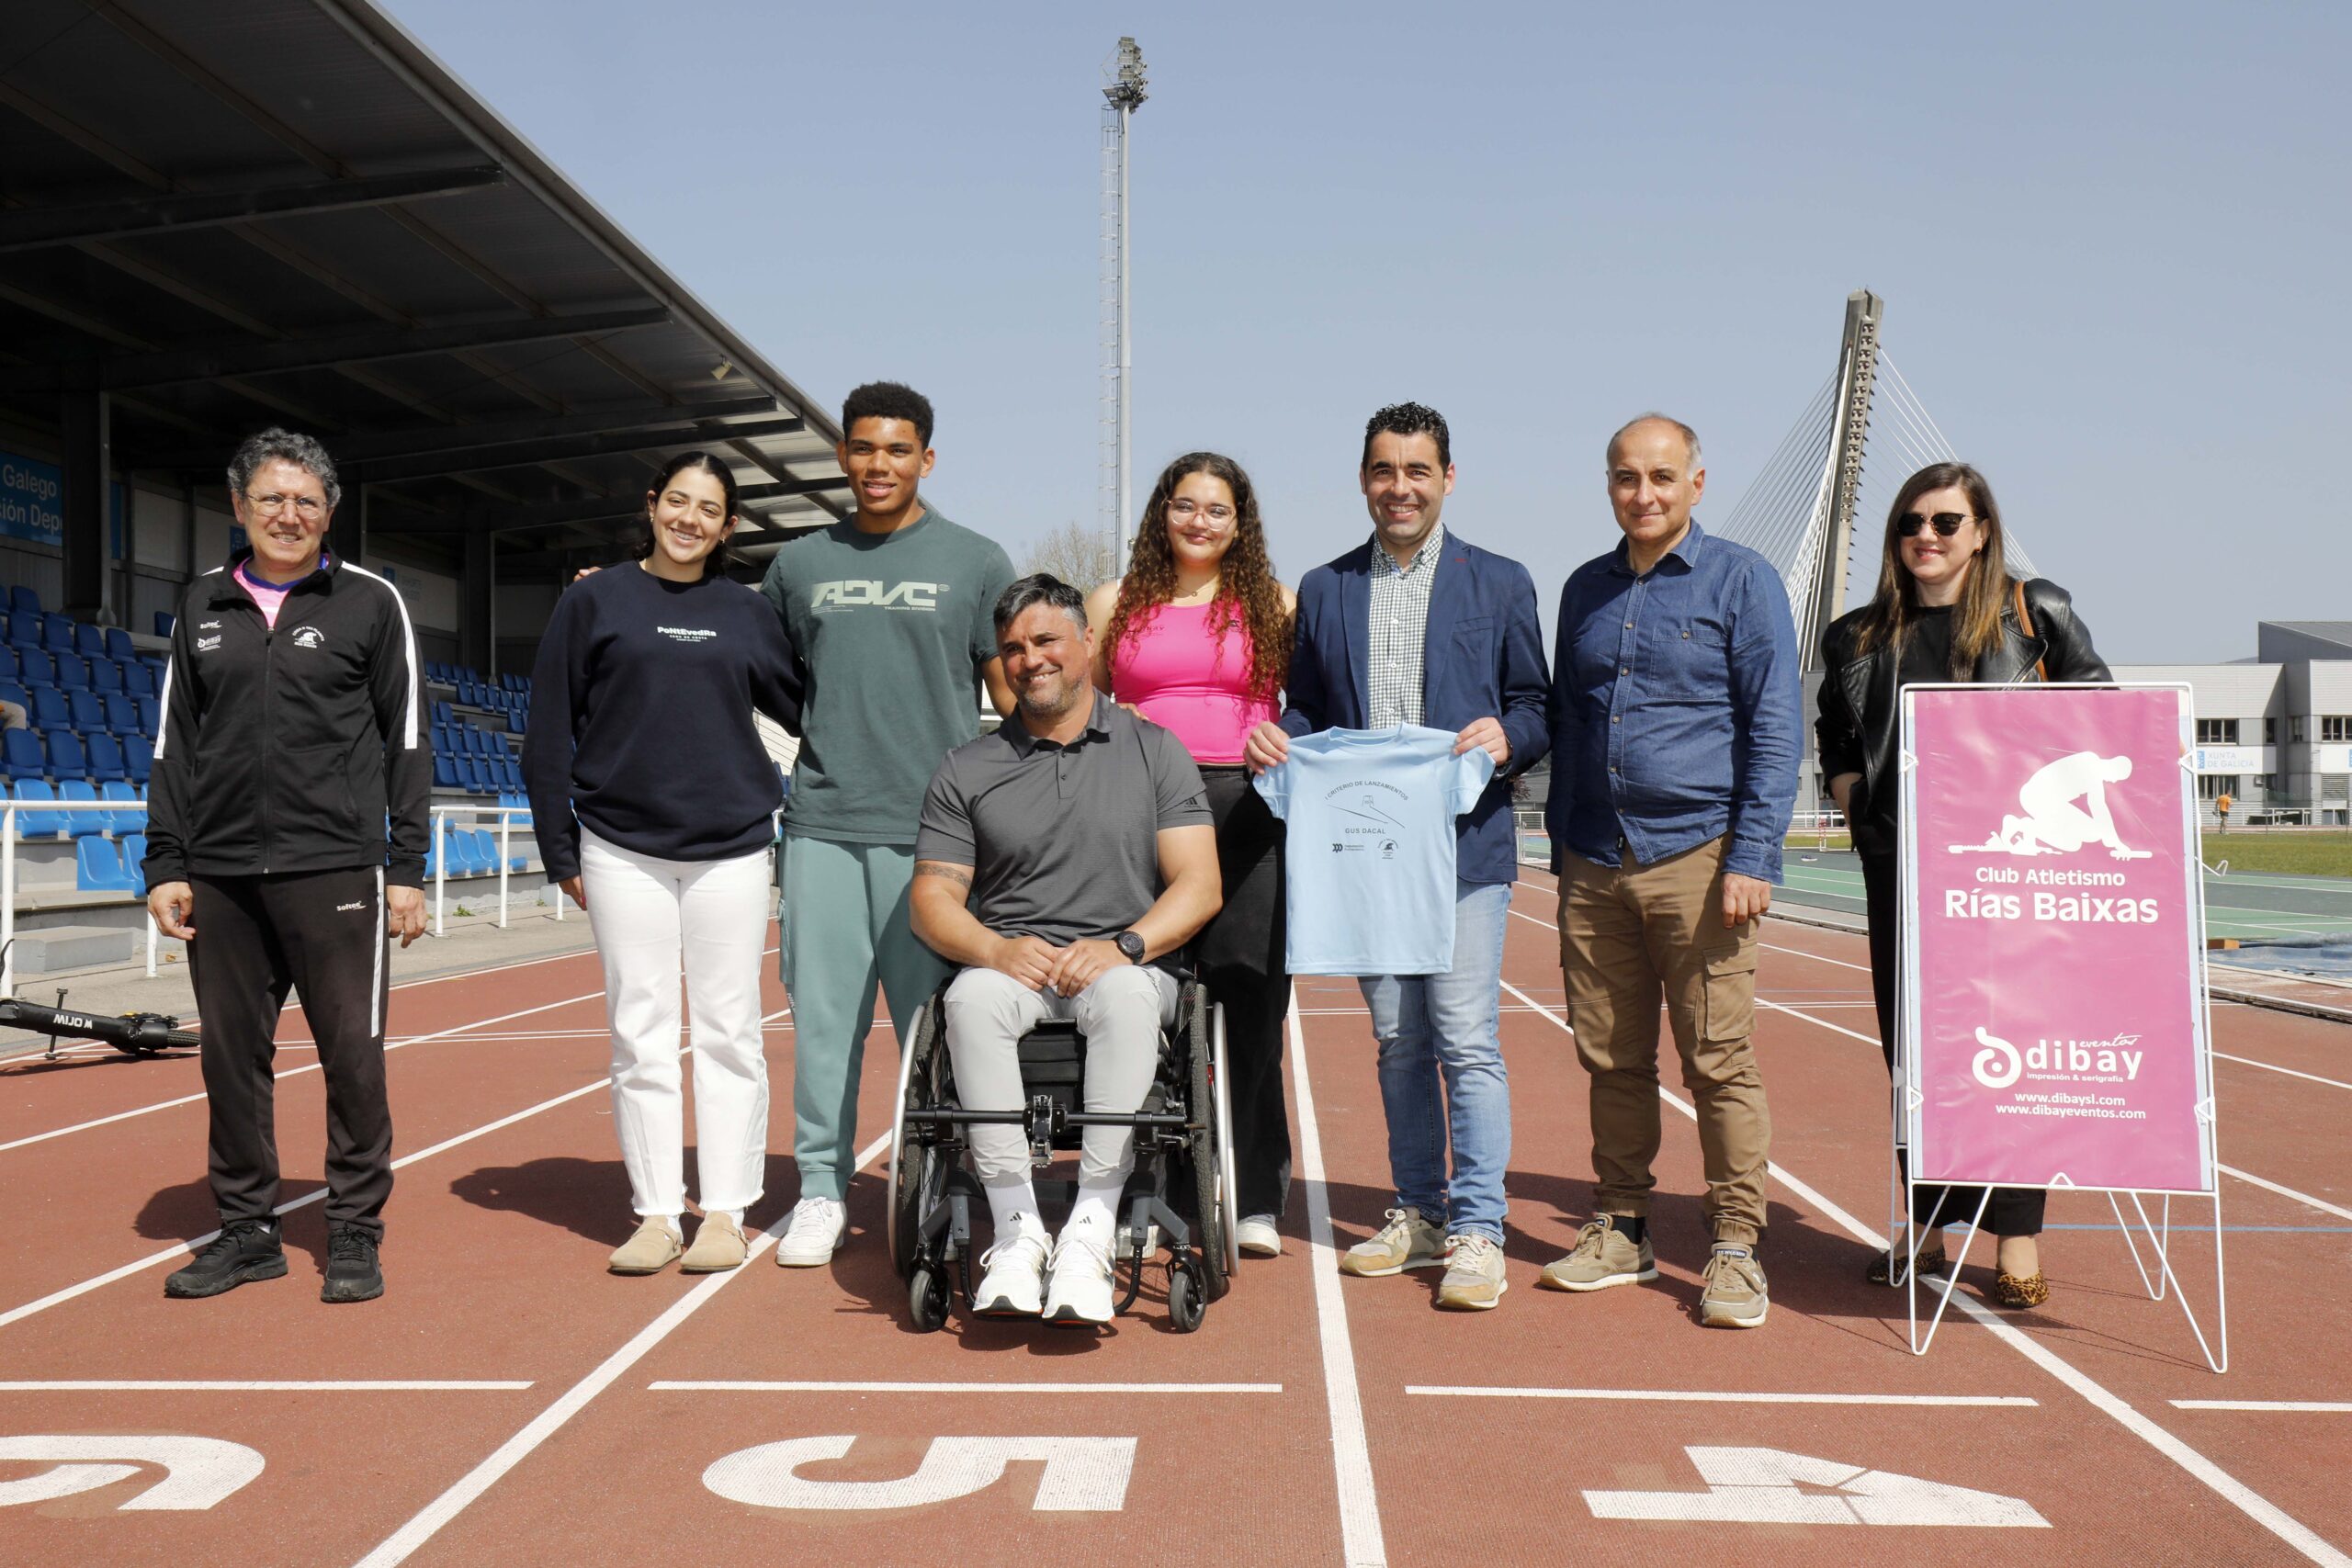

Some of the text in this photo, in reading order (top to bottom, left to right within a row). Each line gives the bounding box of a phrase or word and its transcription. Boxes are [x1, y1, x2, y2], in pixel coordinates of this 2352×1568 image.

[3, 463, 58, 501] Galego
[0, 497, 26, 525] ión
[2207, 751, 2237, 760] XUNTA
[1327, 782, 1354, 799] CRITERIO
[1363, 780, 1409, 801] LANZAMIENTOS
[1975, 866, 2126, 886] Club Atletismo
[1945, 887, 2159, 924] Rías Baixas
[2079, 1032, 2143, 1049] eventos
[2026, 1039, 2143, 1080] dibay
[1996, 1104, 2146, 1119] www.dibayeventos.com
[2015, 1092, 2126, 1107] www.dibaysl.com
[702, 1434, 1137, 1513] 5
[1582, 1445, 2054, 1529] 4
